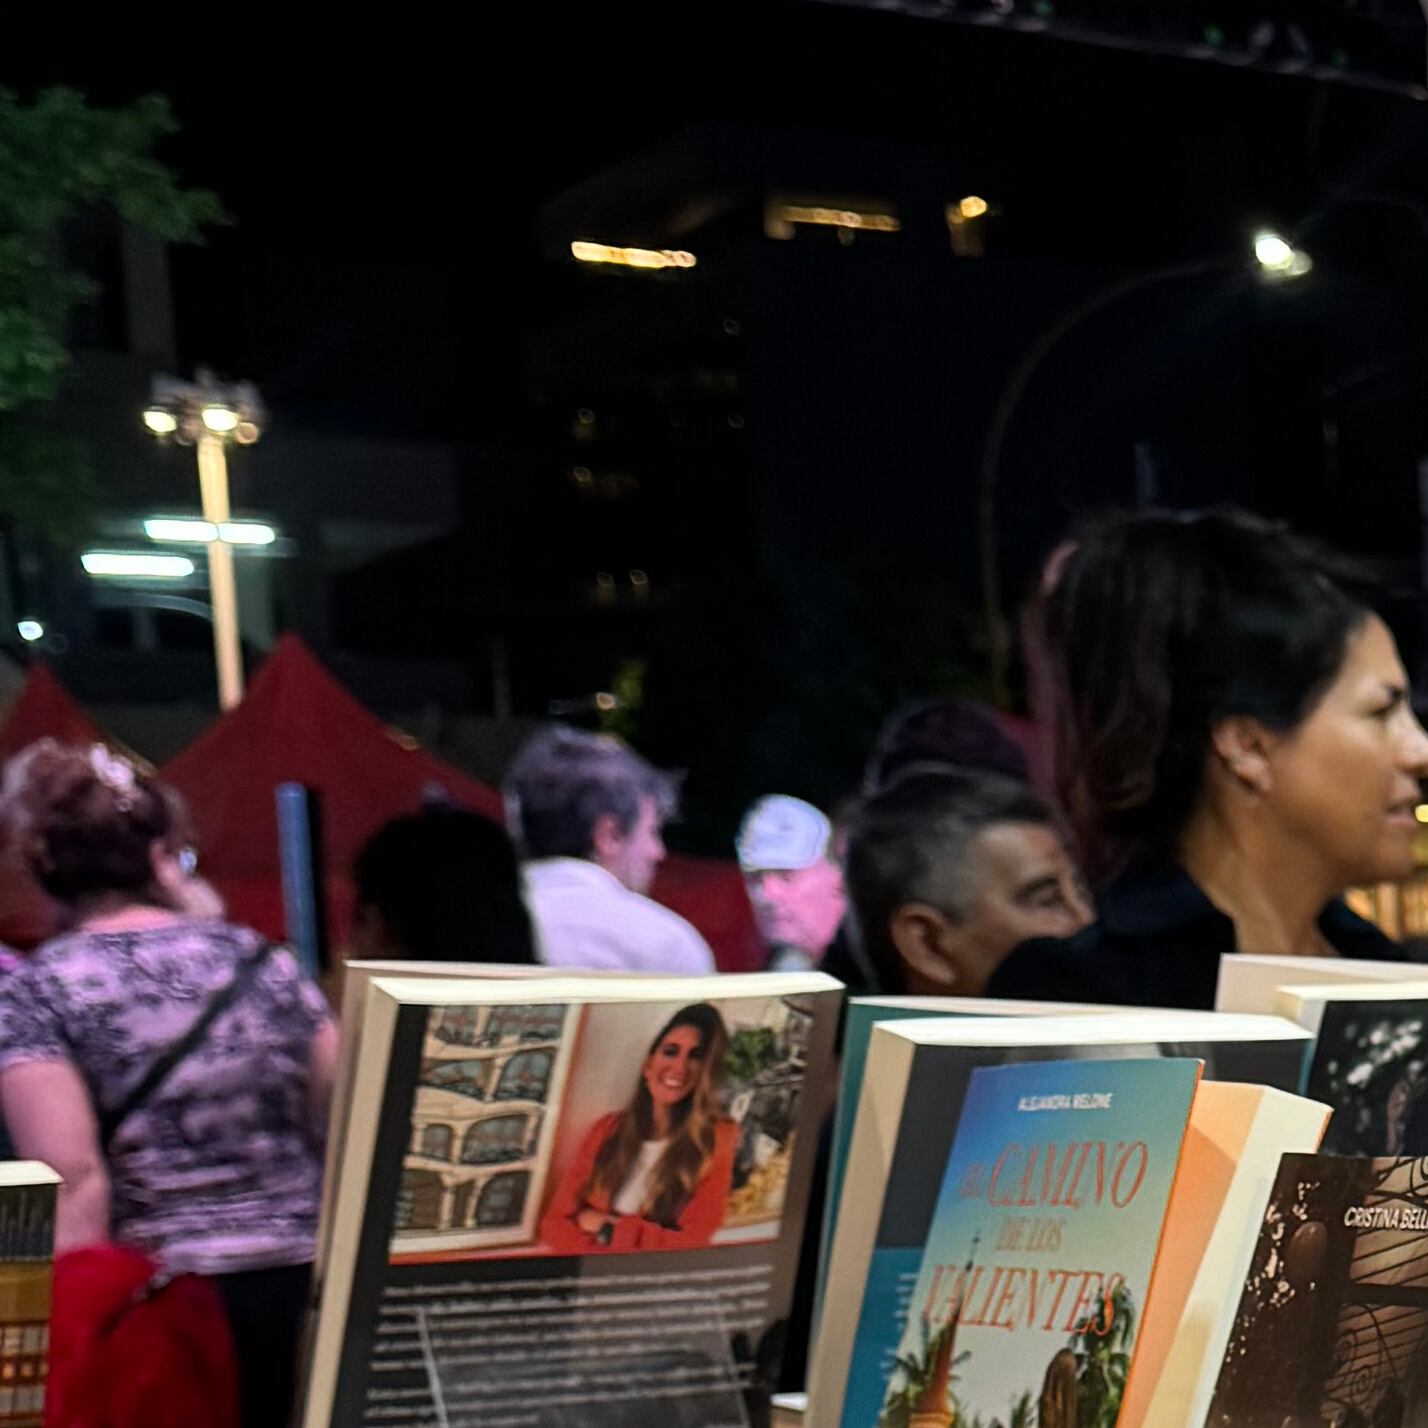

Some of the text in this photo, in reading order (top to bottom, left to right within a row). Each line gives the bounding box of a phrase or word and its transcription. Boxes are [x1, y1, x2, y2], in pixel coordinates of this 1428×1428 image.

[987, 1140, 1149, 1209] CAMINO
[1343, 1206, 1400, 1230] CRISTINA
[922, 1264, 1126, 1336] VALIENTES
